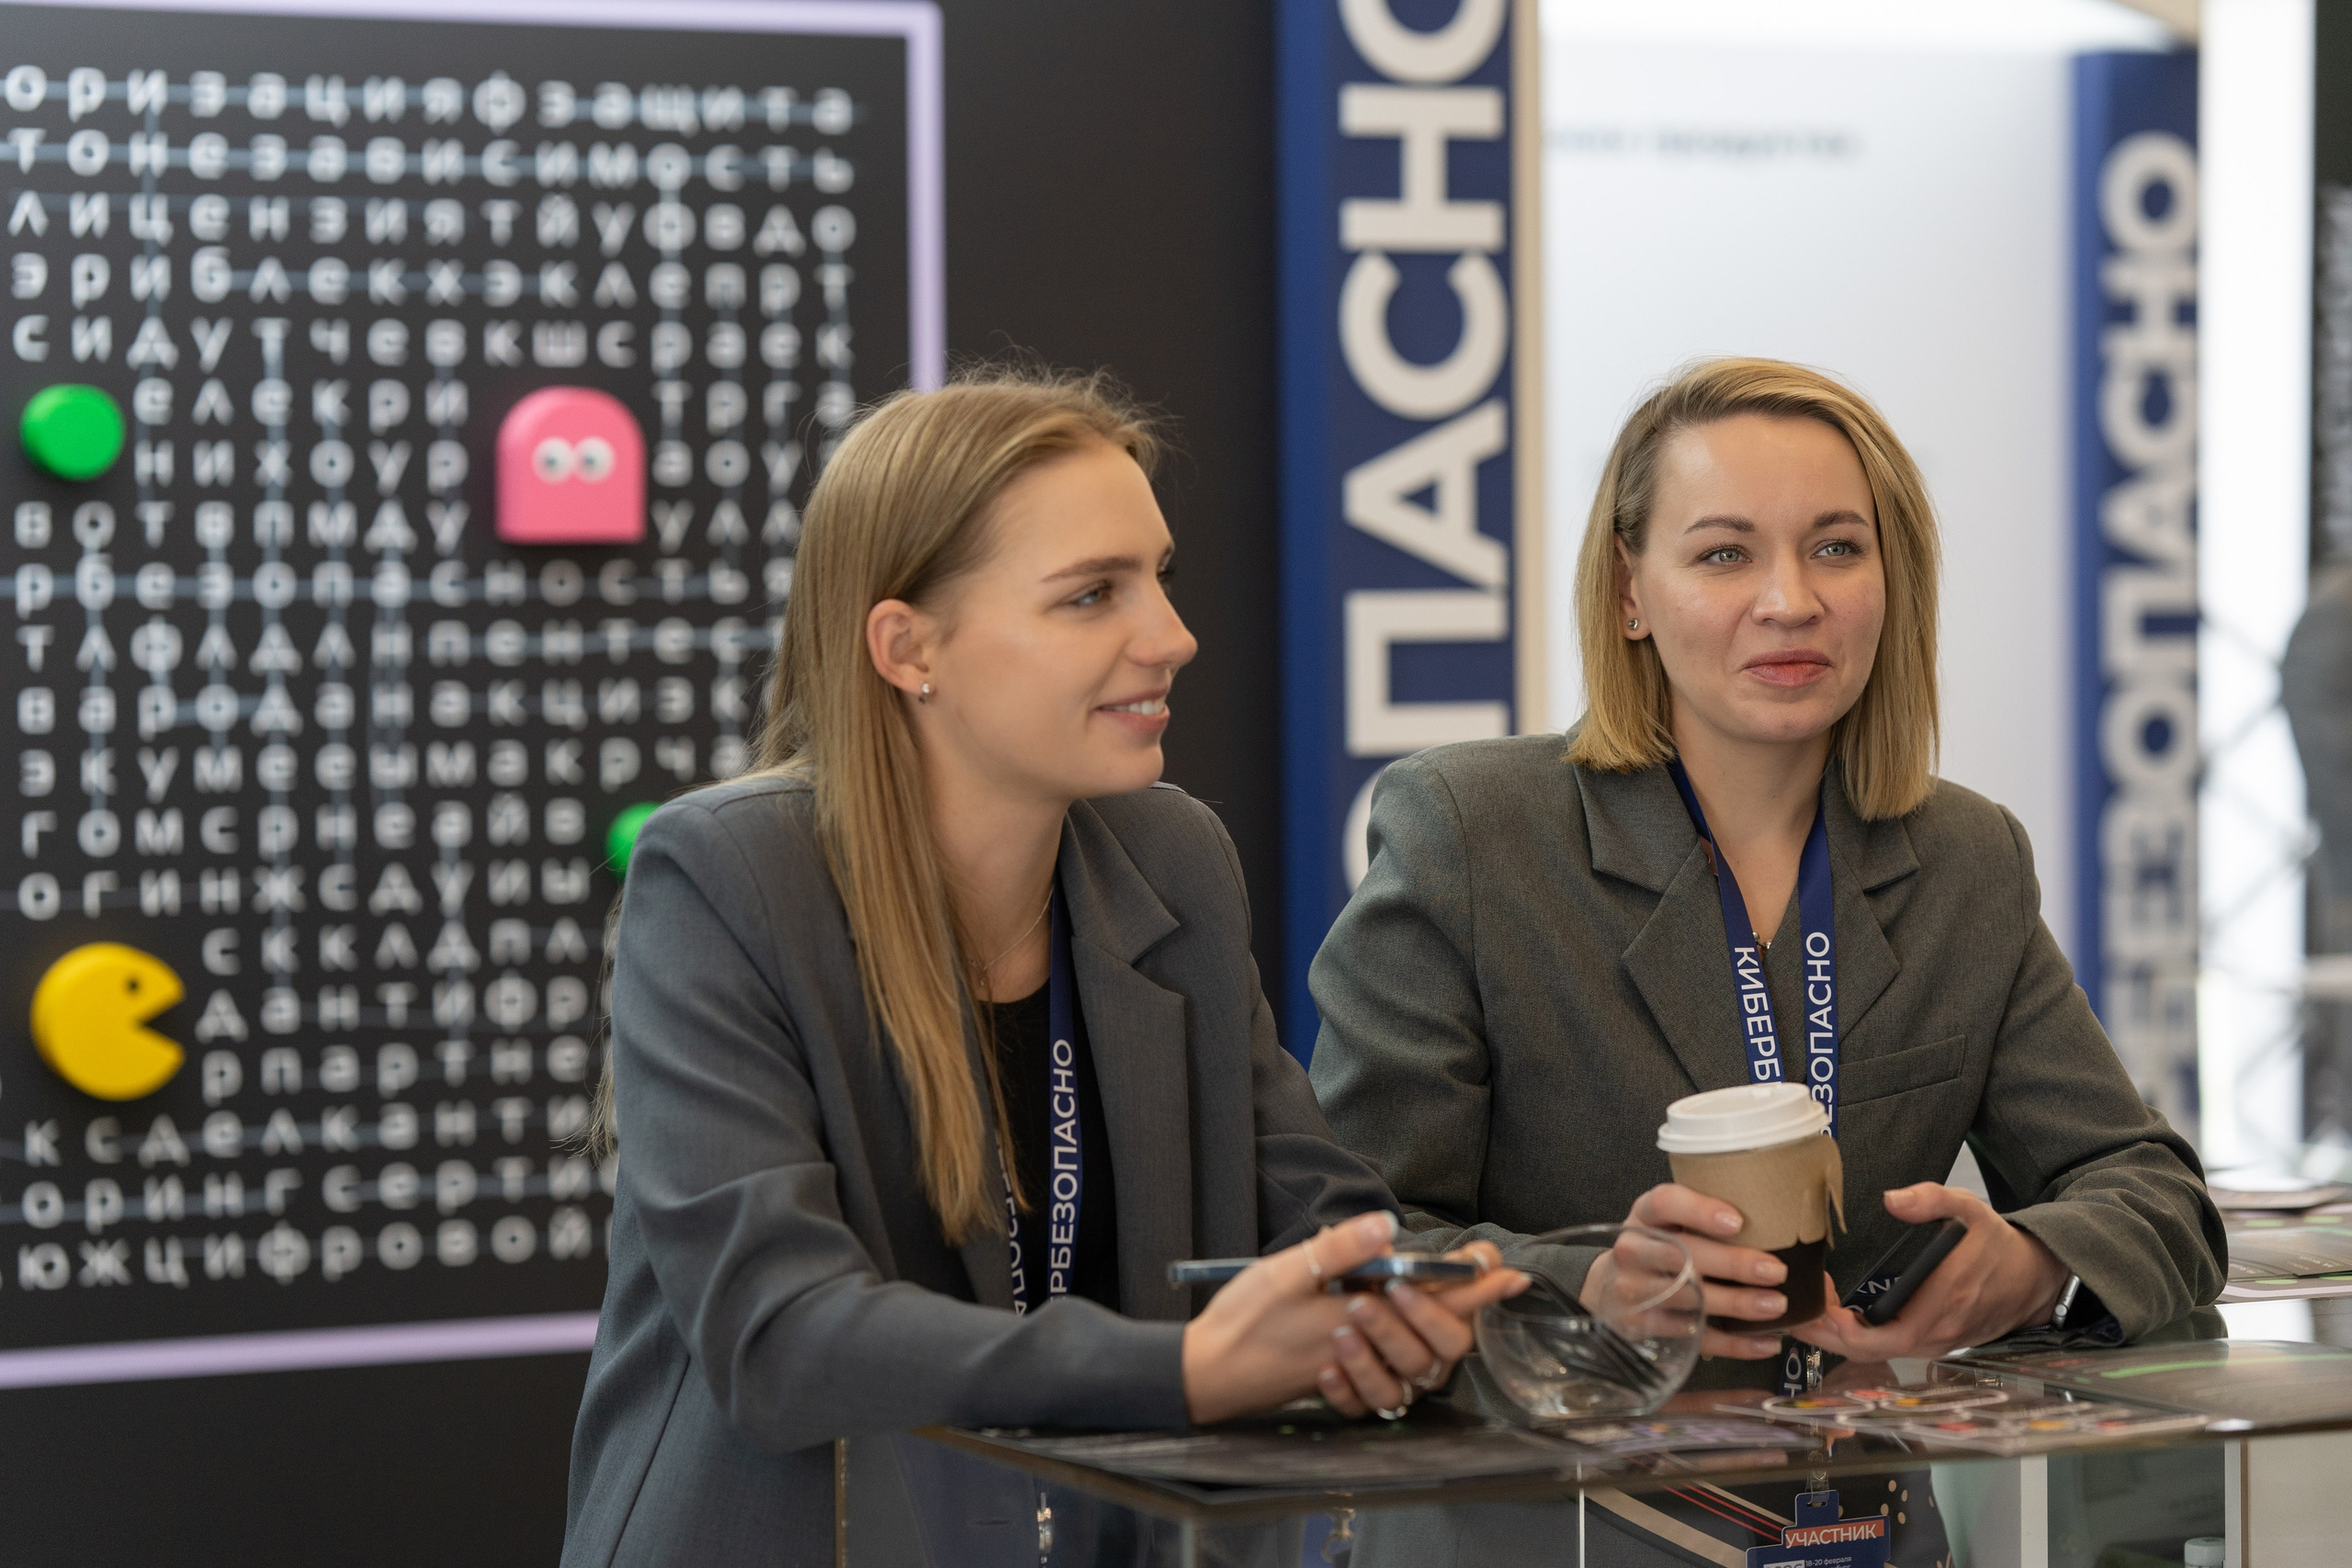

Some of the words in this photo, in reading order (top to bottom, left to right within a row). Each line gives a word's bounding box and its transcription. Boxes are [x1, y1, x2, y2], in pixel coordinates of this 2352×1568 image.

[1340, 0, 1508, 898] ПАСН
[1735, 946, 1784, 1086] КИБЕРБ
[1805, 931, 1835, 1137] ЗОПАСНО
[1049, 1039, 1079, 1303] РБЕЗОПАСНО
[1785, 1524, 1877, 1550] УЧАСТНИК
[1805, 1558, 1824, 1567] 18-20
[1824, 1555, 1852, 1566] февраля
